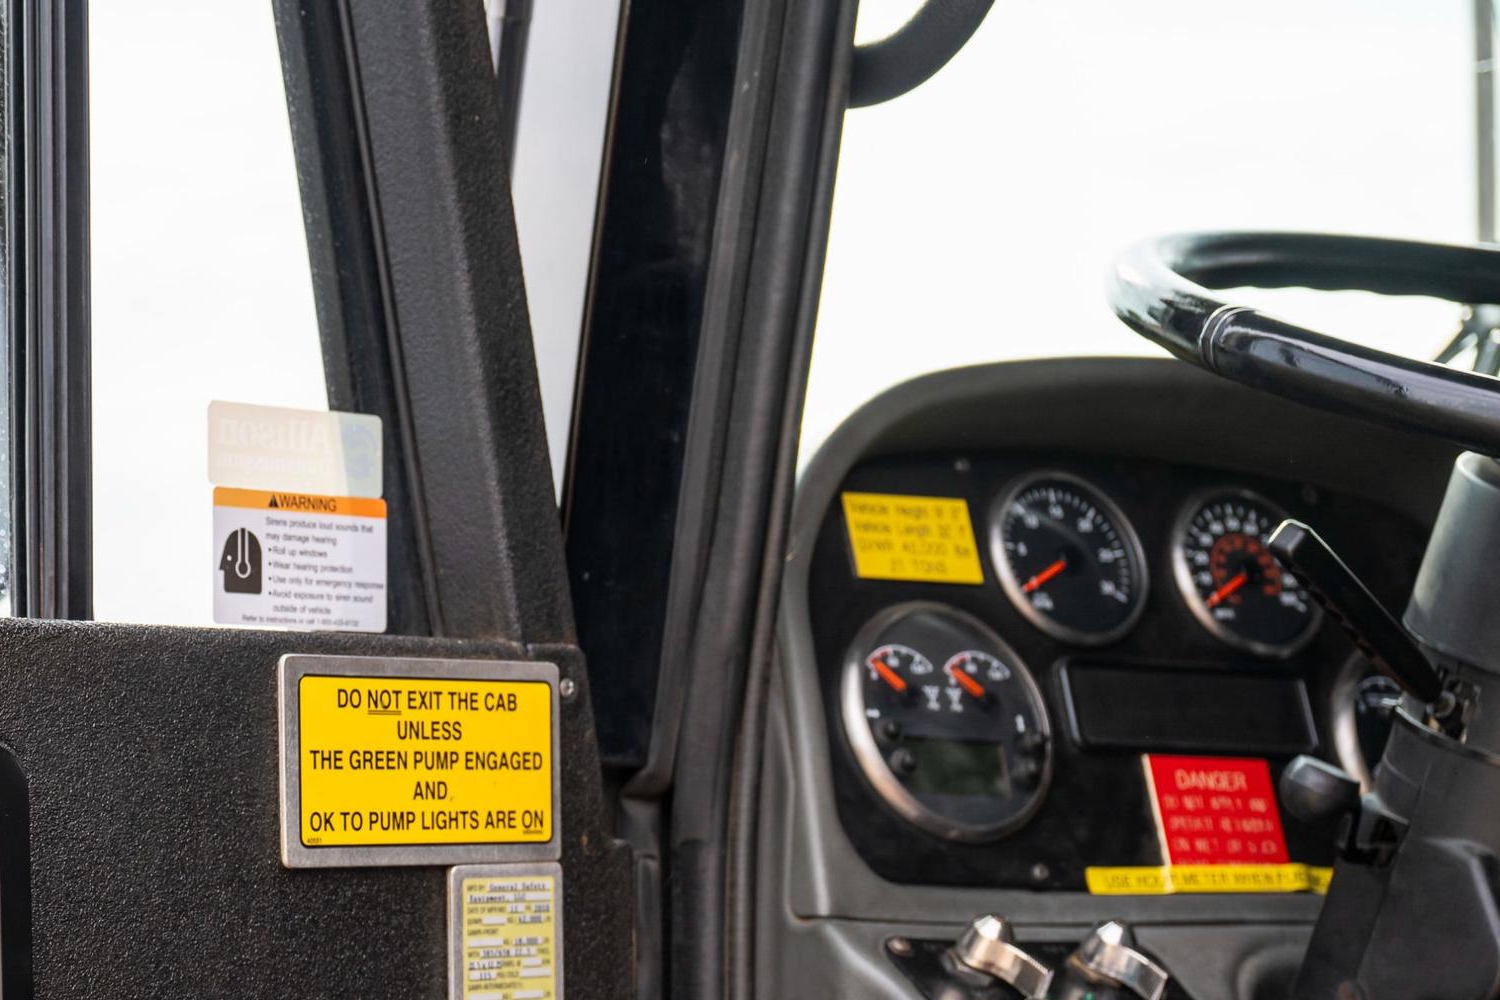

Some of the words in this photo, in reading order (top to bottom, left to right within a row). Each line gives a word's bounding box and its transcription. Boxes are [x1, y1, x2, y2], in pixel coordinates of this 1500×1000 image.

[279, 493, 337, 512] WARNING
[289, 519, 316, 531] produce
[282, 533, 310, 544] damage
[312, 535, 337, 546] hearing
[299, 548, 328, 558] windows
[293, 562, 318, 573] hearing
[337, 688, 362, 709] DO
[367, 689, 402, 713] NOT
[407, 691, 443, 711] EXIT
[448, 692, 478, 712] THE
[484, 693, 517, 712] CAB
[397, 720, 462, 741] UNLESS
[310, 750, 343, 770] THE
[349, 750, 408, 771] GREEN
[414, 751, 460, 771] PUMP
[465, 751, 543, 771] ENGAGED
[1174, 768, 1248, 792] DANGER
[413, 781, 448, 801] AND
[310, 812, 335, 832] OK
[340, 812, 363, 831] TO
[369, 811, 416, 831] PUMP
[421, 811, 480, 831] LIGHTS
[485, 810, 517, 830] ARE
[522, 810, 544, 829] ON
